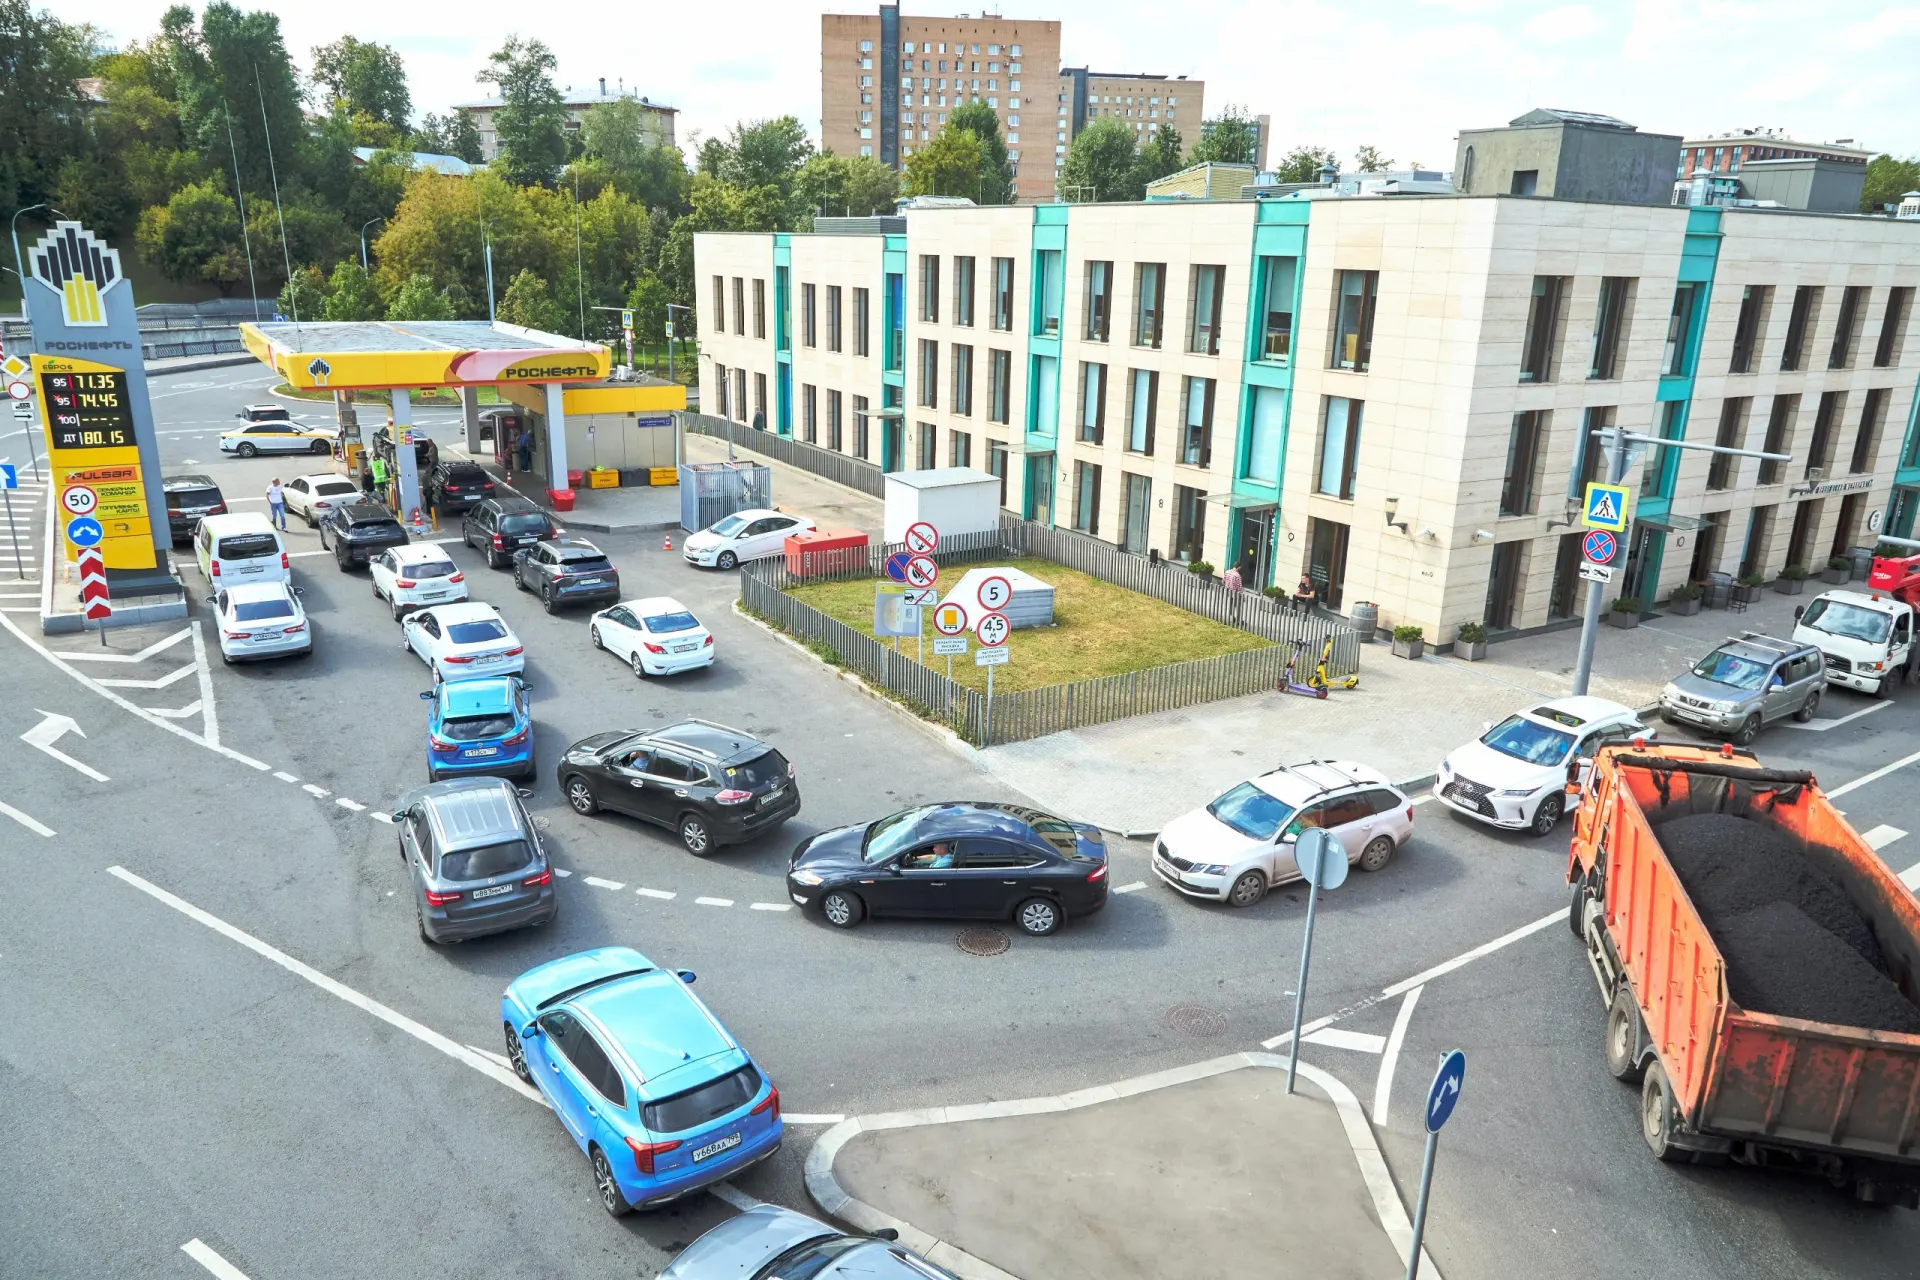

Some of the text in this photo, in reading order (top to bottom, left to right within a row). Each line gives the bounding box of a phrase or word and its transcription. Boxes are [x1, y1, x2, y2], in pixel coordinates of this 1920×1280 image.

[44, 341, 132, 350] РОСНЕФТЬ
[506, 367, 597, 378] РОСНЕФТЬ
[53, 375, 115, 389] 95 71.35
[57, 393, 118, 408] 95 74.45
[60, 416, 77, 424] 100
[63, 431, 124, 445] ДТ 80.15
[69, 494, 90, 507] 50
[1158, 498, 1164, 509] 8
[1287, 532, 1295, 543] 9
[989, 586, 998, 601] 5
[984, 619, 1003, 632] 4,5
